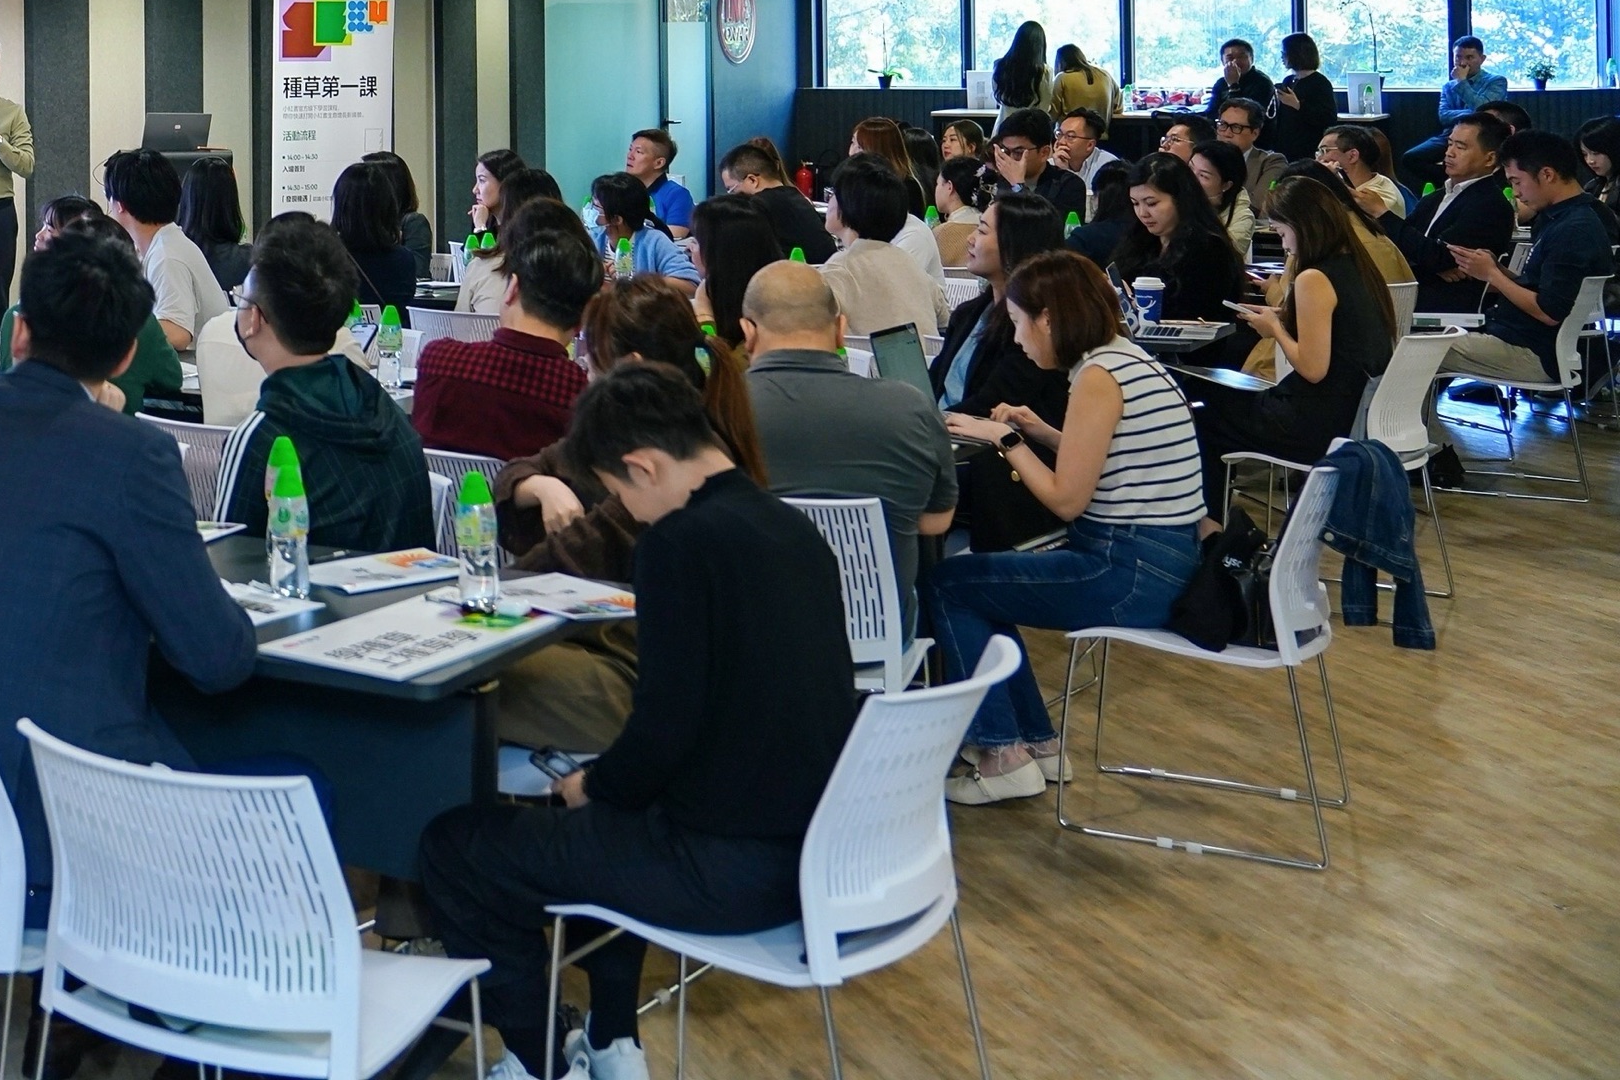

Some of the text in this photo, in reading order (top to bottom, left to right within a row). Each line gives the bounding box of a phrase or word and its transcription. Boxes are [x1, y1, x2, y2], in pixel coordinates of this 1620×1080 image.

[283, 75, 377, 99] 種草第一課
